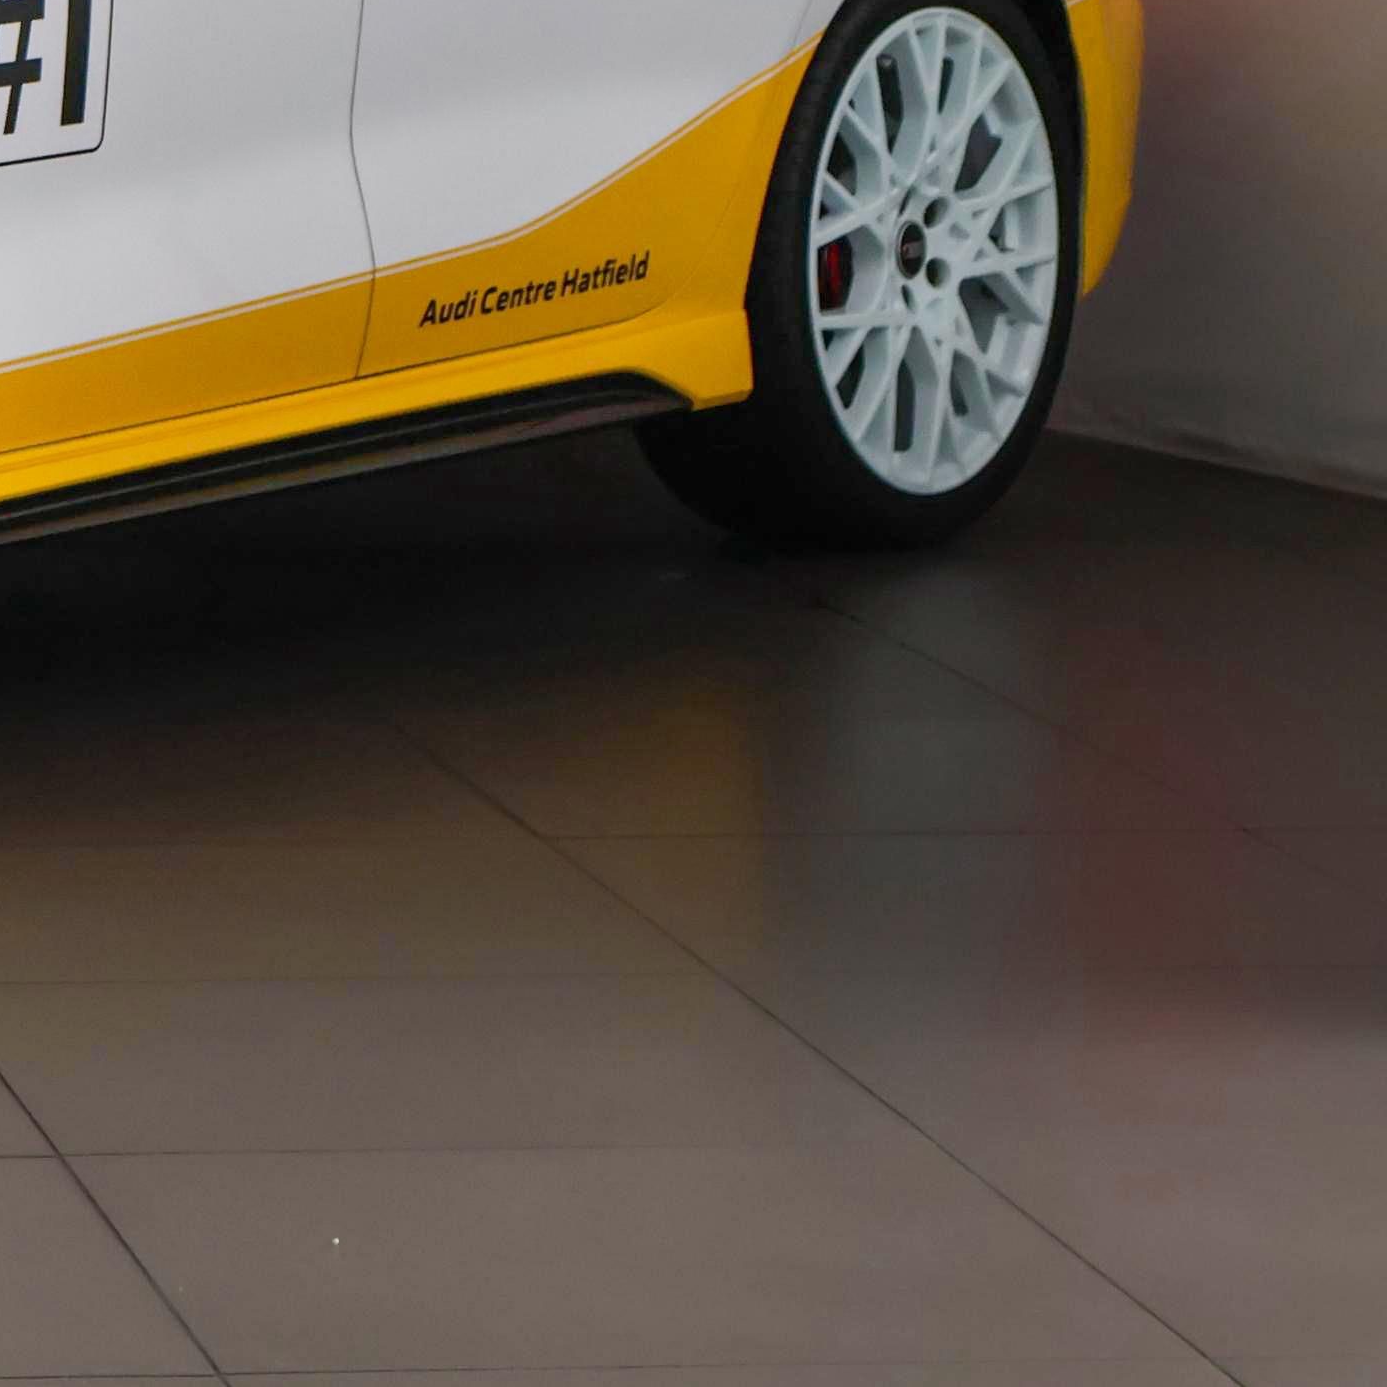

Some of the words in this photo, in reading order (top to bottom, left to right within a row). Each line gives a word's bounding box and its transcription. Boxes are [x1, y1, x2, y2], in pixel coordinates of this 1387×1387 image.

[418, 289, 478, 328] Audi
[480, 281, 557, 315] Centre
[559, 250, 651, 298] Hatfield
